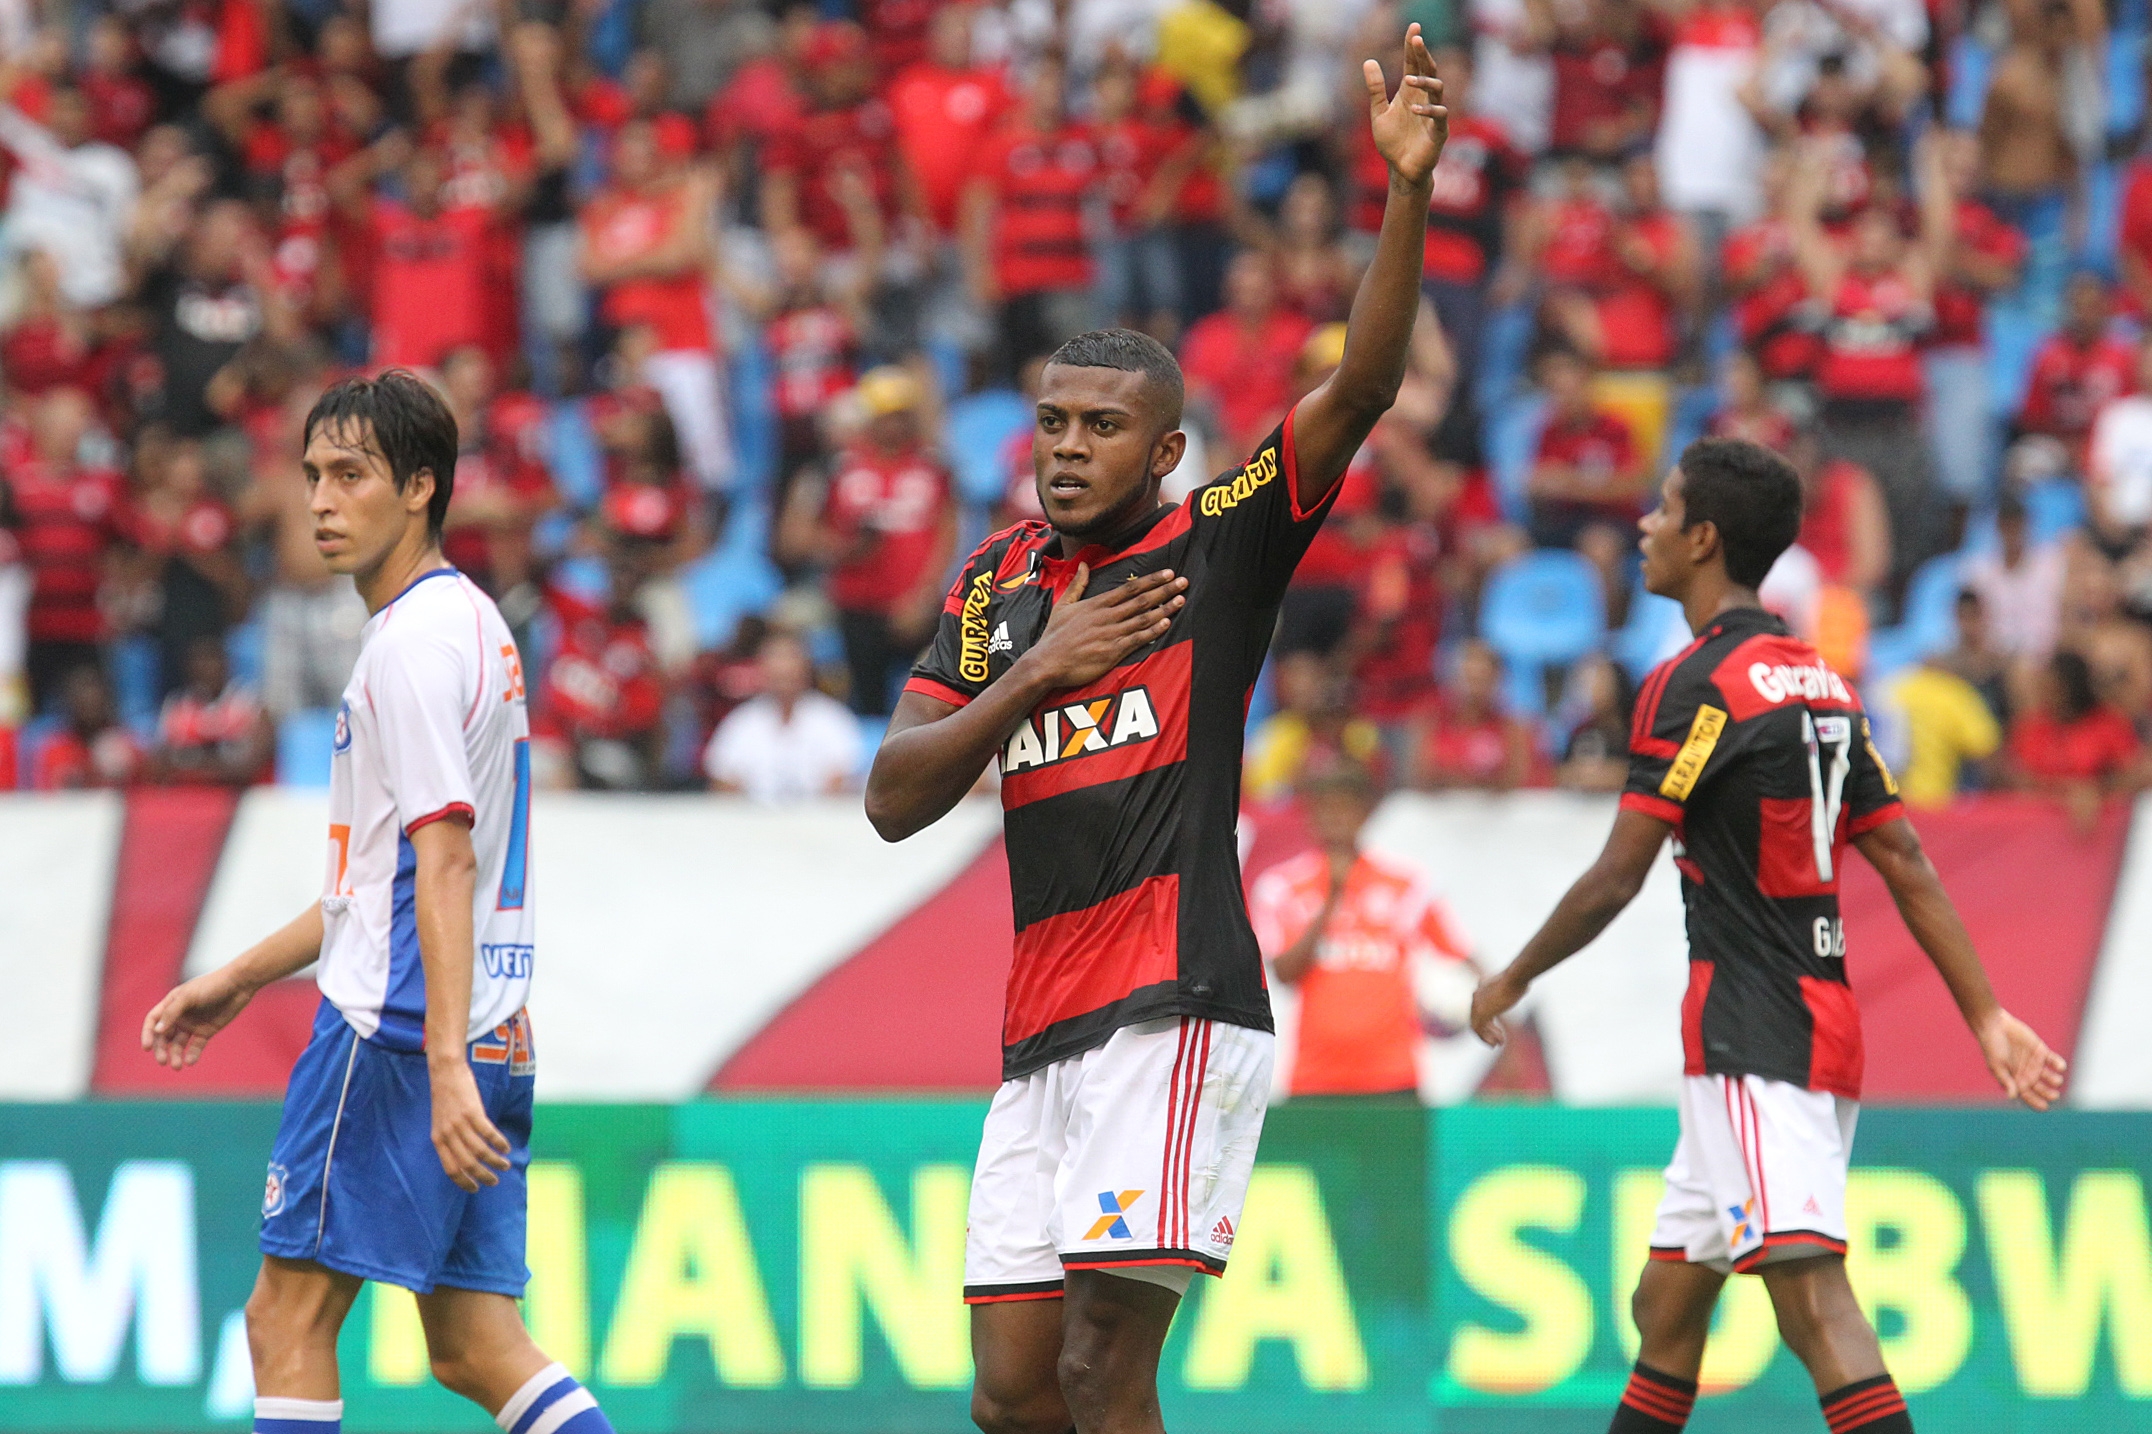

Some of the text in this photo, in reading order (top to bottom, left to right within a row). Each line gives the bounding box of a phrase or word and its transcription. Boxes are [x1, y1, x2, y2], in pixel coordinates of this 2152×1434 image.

[1001, 688, 1158, 775] AIXA
[1801, 709, 1852, 882] 17
[366, 1157, 1371, 1394] ANA
